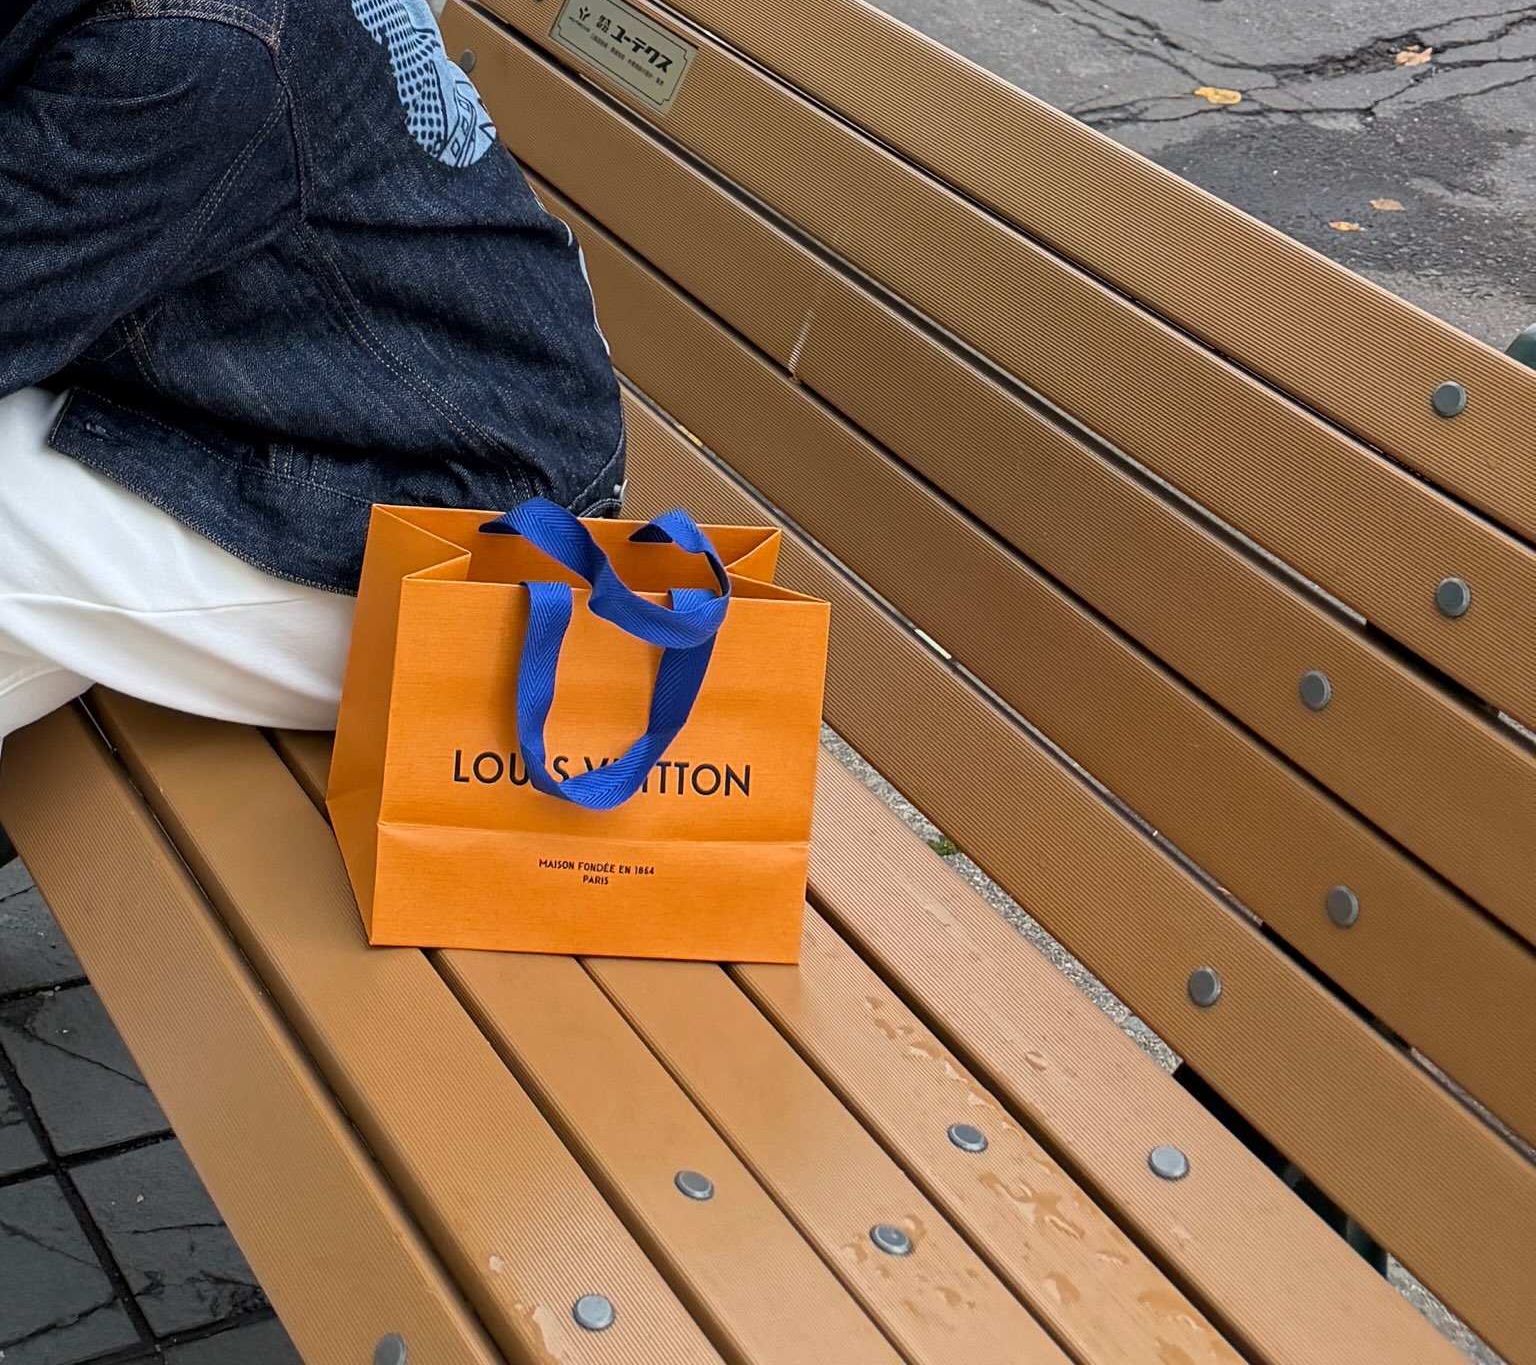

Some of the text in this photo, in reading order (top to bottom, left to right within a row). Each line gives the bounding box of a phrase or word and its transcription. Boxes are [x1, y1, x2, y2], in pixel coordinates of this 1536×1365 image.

[610, 25, 673, 73] ユーテクス
[453, 748, 752, 797] LOUS TTON
[538, 859, 575, 870] MAISON
[577, 861, 615, 873] FONDÉE
[618, 865, 631, 874] EN
[582, 875, 610, 885] PARIS
